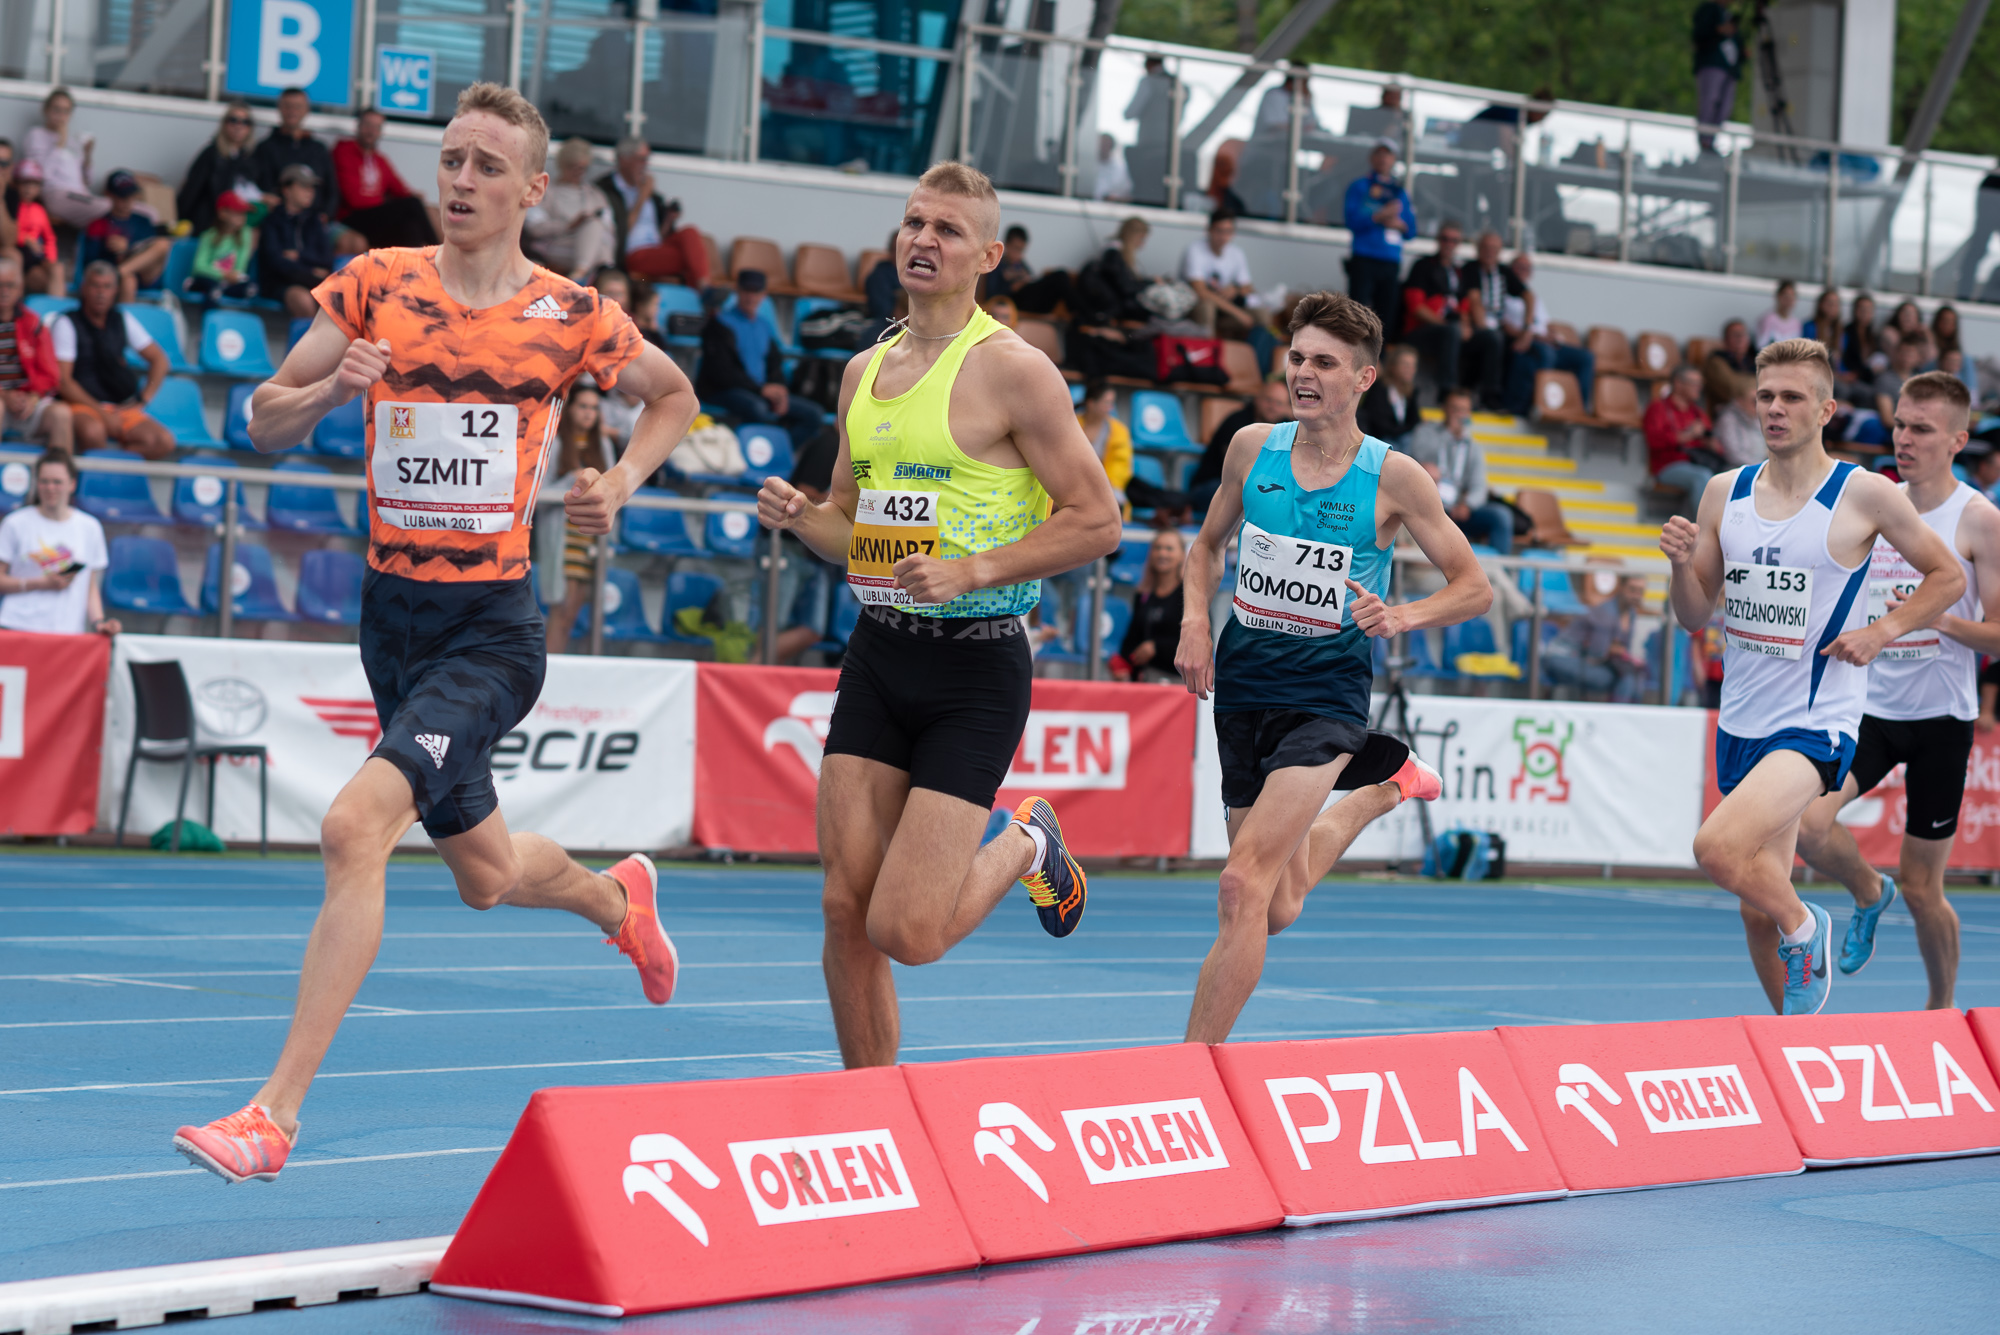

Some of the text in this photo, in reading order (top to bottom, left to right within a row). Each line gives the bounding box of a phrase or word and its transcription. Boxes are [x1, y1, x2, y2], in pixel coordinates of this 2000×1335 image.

[257, 0, 322, 89] B
[382, 56, 429, 89] WC
[523, 308, 568, 320] adidas
[460, 410, 499, 438] 12
[396, 457, 489, 486] SZMIT
[411, 502, 463, 512] MISTRZOSTWA
[883, 496, 930, 521] 432
[1317, 510, 1354, 521] Pomorze
[1320, 500, 1355, 513] WMLKS
[403, 514, 482, 530] LUBLIN 2021
[1255, 540, 1271, 551] PGE
[1295, 543, 1344, 572] 713
[1240, 564, 1339, 610] KOMODA
[1725, 568, 1750, 584] 4F
[1766, 570, 1806, 592] 153
[862, 589, 915, 605] LUBLIN 2021
[1245, 615, 1313, 636] LUBLIN 2021
[1738, 640, 1785, 656] LUBLIN 2021
[1901, 649, 1921, 659] 2021
[415, 734, 443, 769] adidas
[1010, 725, 1114, 775] LEN
[1781, 1040, 1996, 1125] PZLA
[1640, 1075, 1756, 1124] ORLEN
[1265, 1066, 1529, 1171] PZLA
[1078, 1109, 1215, 1172] ORLEN
[749, 1143, 903, 1211] ORLEN
